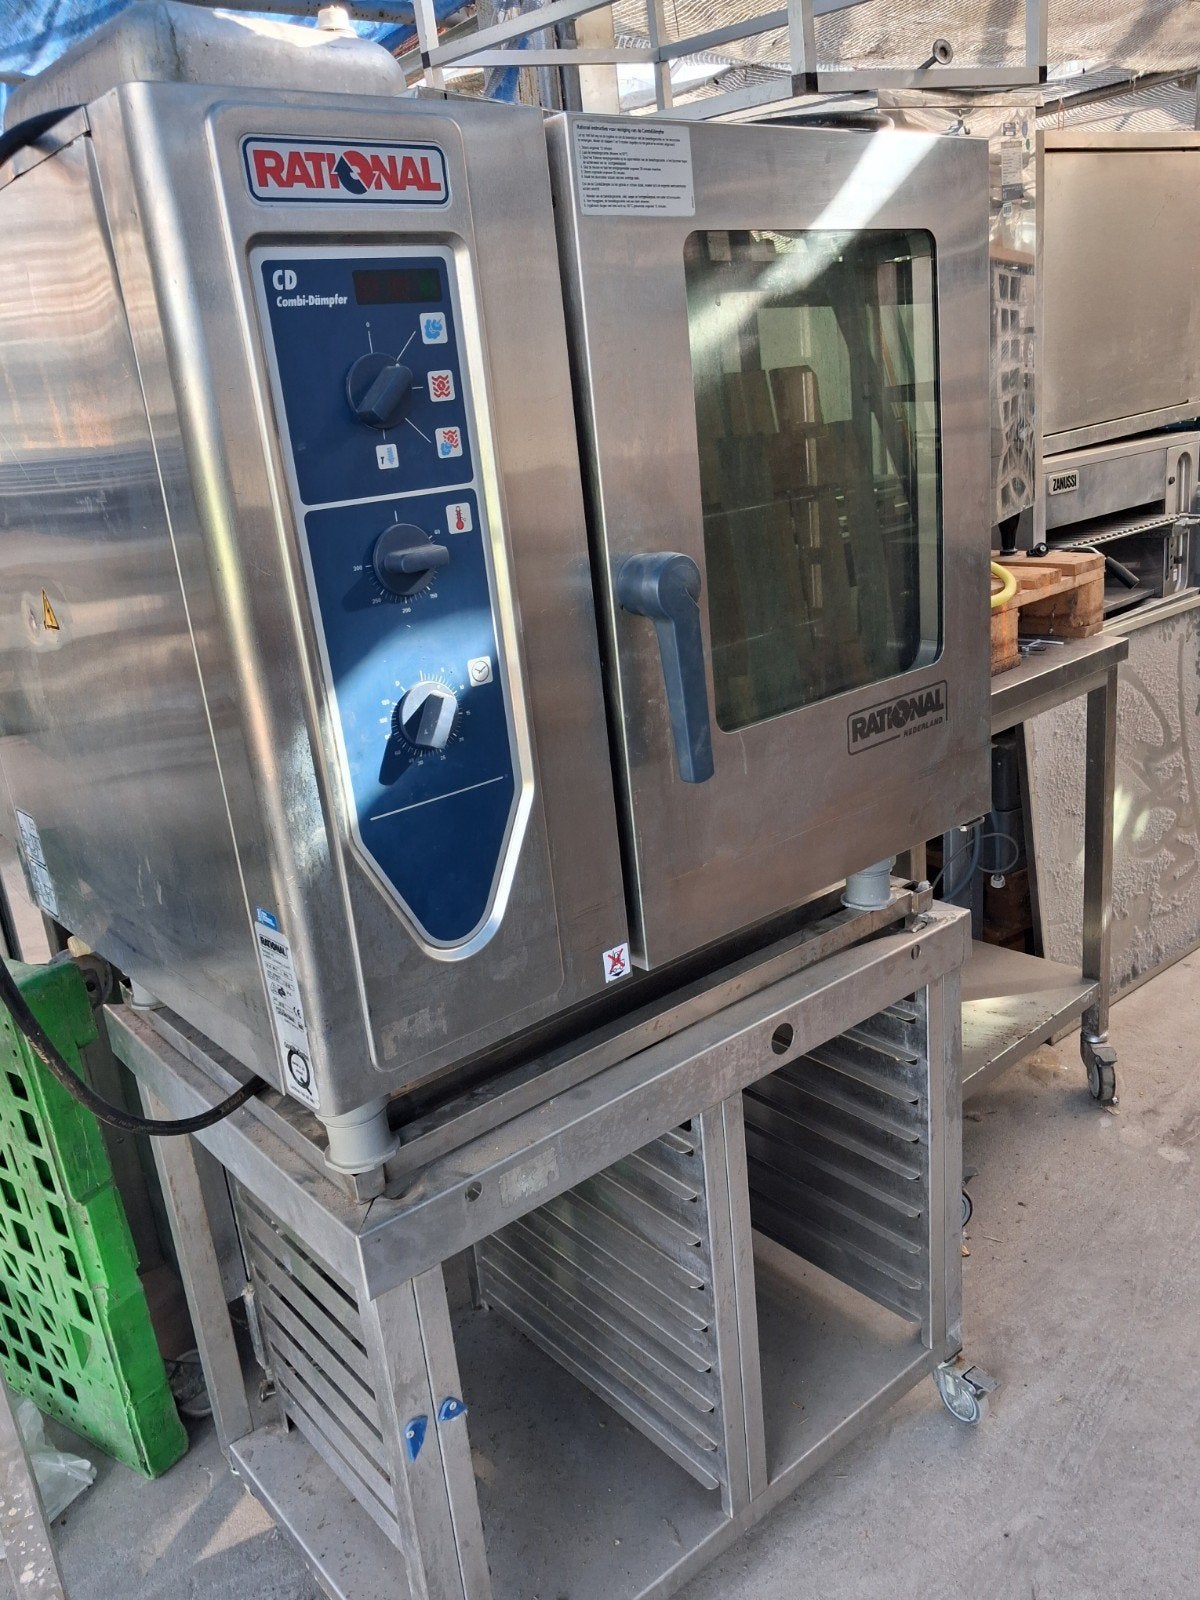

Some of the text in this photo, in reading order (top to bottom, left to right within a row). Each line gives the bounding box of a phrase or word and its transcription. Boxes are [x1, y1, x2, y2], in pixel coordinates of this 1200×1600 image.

[253, 150, 442, 195] RATIONAL
[272, 269, 298, 291] CD
[276, 293, 348, 308] Combi-Dämpfer
[1053, 474, 1077, 491] ZANUSSI
[852, 688, 945, 744] RATIONAL
[903, 716, 943, 738] NEDERLAND
